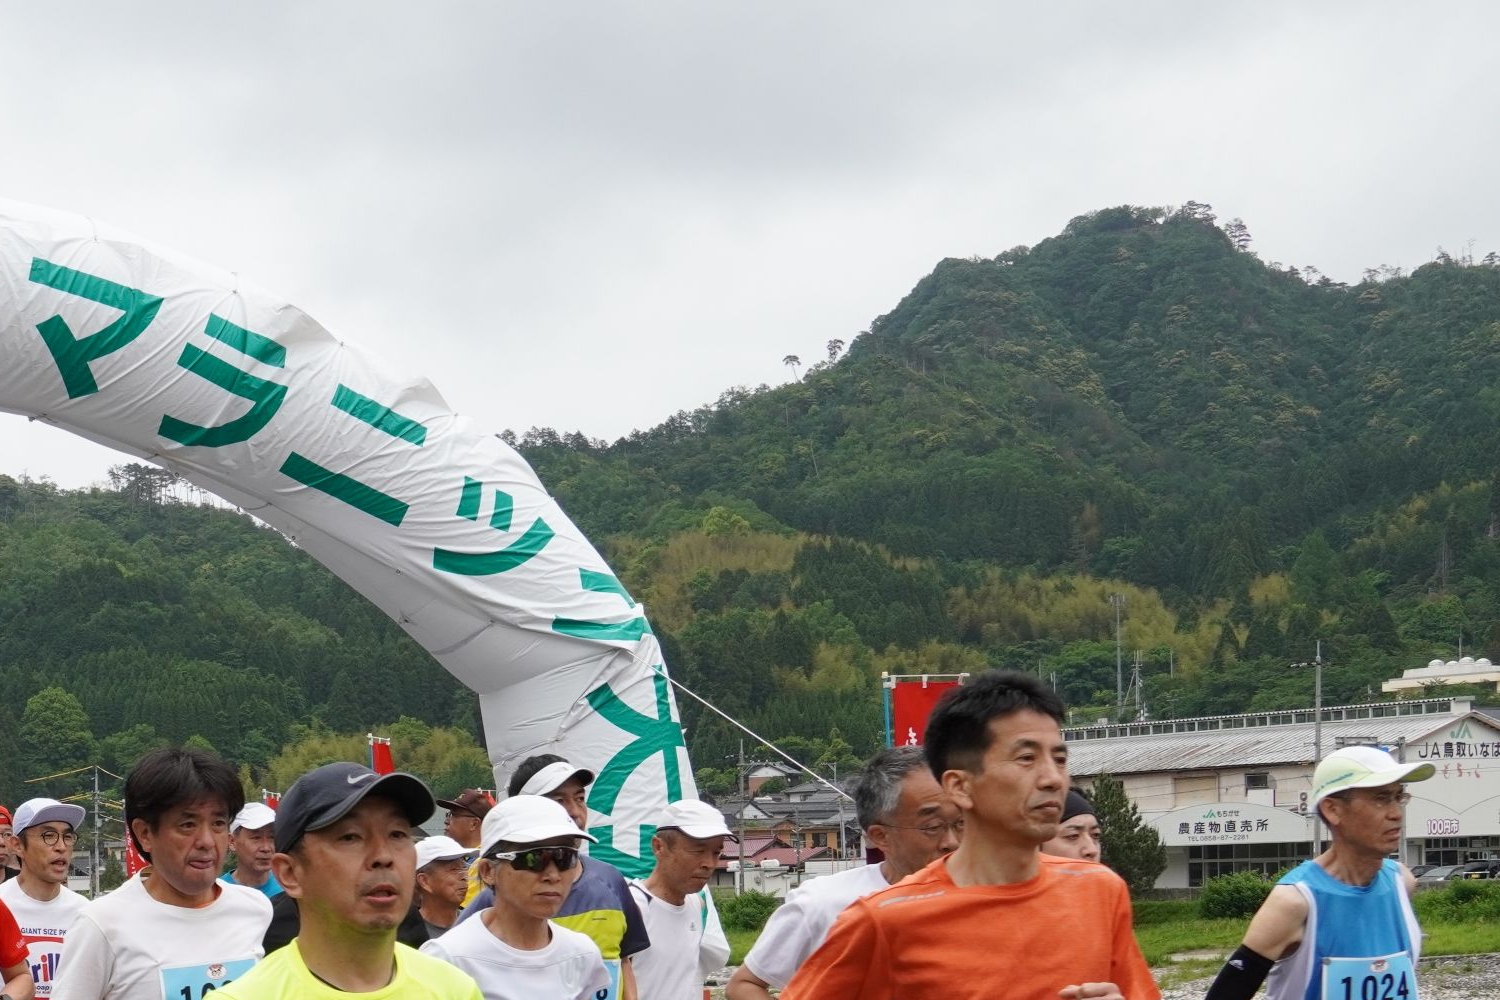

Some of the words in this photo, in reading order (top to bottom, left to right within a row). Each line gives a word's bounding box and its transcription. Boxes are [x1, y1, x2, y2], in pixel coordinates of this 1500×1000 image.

[1178, 818, 1269, 834] 農産物直売所
[1426, 819, 1460, 835] 100円市
